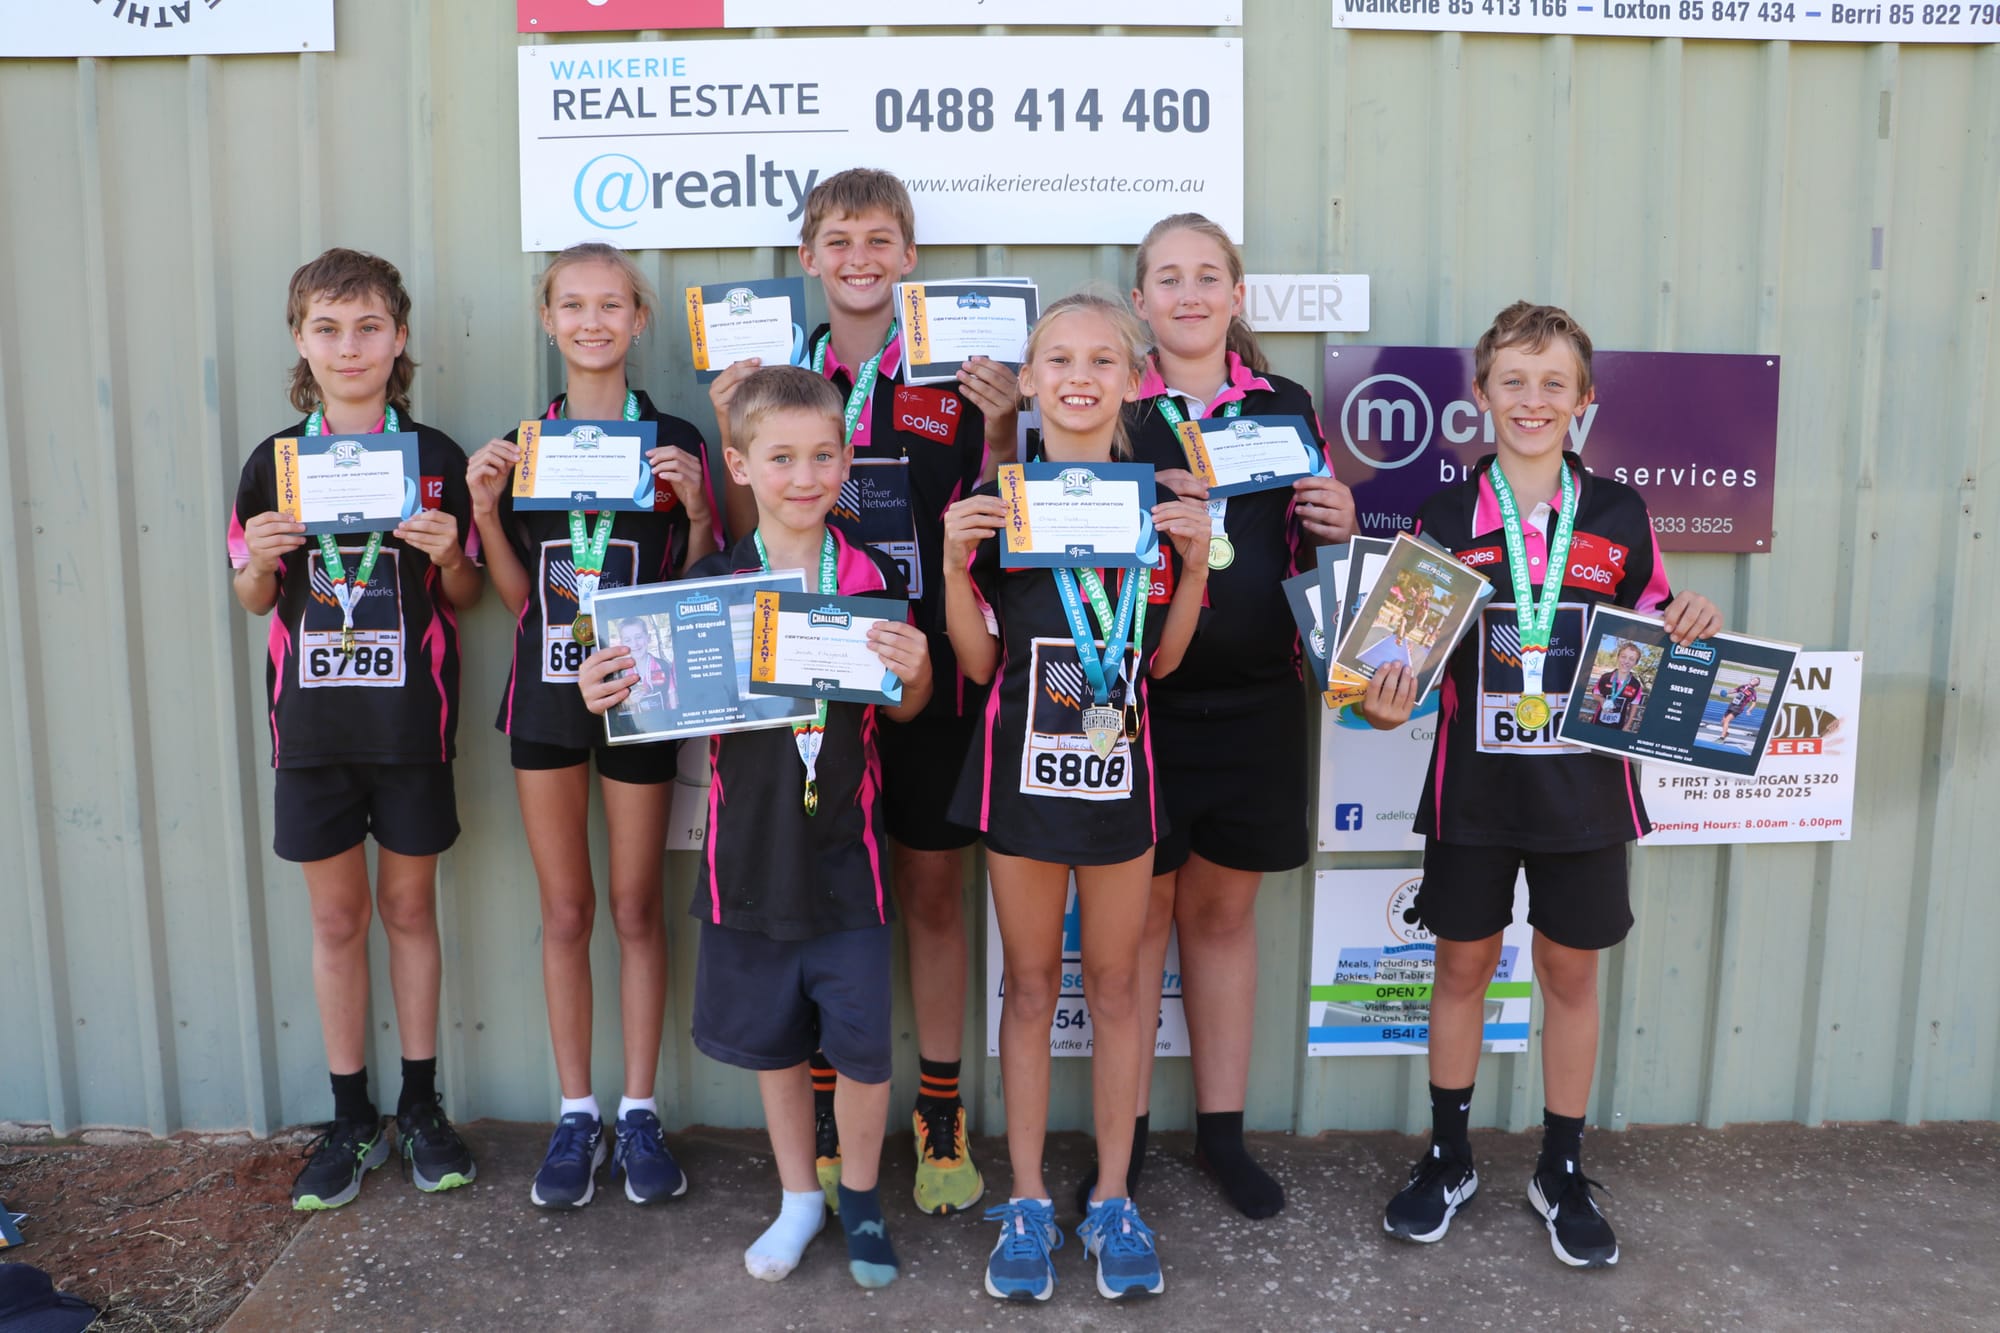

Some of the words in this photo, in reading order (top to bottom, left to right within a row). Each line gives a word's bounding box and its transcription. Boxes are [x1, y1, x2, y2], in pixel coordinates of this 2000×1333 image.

[1448, 0, 1473, 15] 85
[1482, 0, 1520, 16] 413
[1530, 0, 1567, 17] 166
[1604, 0, 1670, 20] Loxton
[1679, 1, 1702, 21] 85
[1711, 1, 1750, 22] 847
[1757, 2, 1796, 23] 434
[1832, 4, 1881, 24] Berri
[1889, 4, 1914, 25] 85
[1922, 4, 1961, 25] 822
[550, 57, 687, 80] WAIKERIE
[553, 86, 657, 121] REAL
[670, 82, 820, 118] ESTATE
[875, 87, 994, 133] 0488
[1014, 88, 1103, 132] 414
[1122, 88, 1210, 133] 460
[940, 397, 958, 415] 12
[902, 414, 949, 437] coles
[282, 444, 294, 505] PARTICIPANT
[861, 478, 875, 488] SA
[1066, 473, 1089, 487] SIC
[1614, 463, 1758, 488] services
[427, 481, 443, 498] 12
[862, 489, 891, 499] Power
[862, 498, 908, 509] Networks
[1008, 470, 1022, 533] PARTICIPANT
[1361, 512, 1413, 530] White
[1506, 515, 1519, 532] SA
[1691, 517, 1733, 533] 3525
[571, 519, 586, 554] Little
[1553, 536, 1568, 553] SA
[1460, 550, 1495, 567] coles
[1511, 534, 1529, 592] Athletics
[1608, 546, 1623, 567] 12
[1546, 554, 1564, 590] State
[1571, 563, 1613, 585] coles
[680, 601, 718, 616] CHALLENGE
[1519, 593, 1533, 630] Little
[1537, 592, 1556, 631] Event
[811, 615, 848, 626] CHALLENGE
[1072, 608, 1087, 637] STATE
[762, 598, 771, 663] PARTICIPANT
[310, 646, 394, 677] 6788
[1674, 645, 1713, 661] CHALLENGE
[1667, 662, 1688, 672] Noah
[1035, 752, 1125, 788] 6808
[1658, 777, 1666, 788] 5
[1672, 776, 1708, 787] FIRST
[1804, 773, 1839, 785] 5320
[1684, 789, 1707, 800] PH:
[1713, 789, 1730, 799] 08
[1736, 788, 1771, 799] 8540
[1776, 787, 1812, 798] 2025
[1649, 821, 1699, 832] Opening
[1703, 820, 1741, 830] Hours:
[1745, 819, 1788, 829] 8.00am
[1799, 817, 1842, 829] 6.00pm
[1392, 893, 1407, 916] THE
[1338, 959, 1371, 969] Meals,
[1335, 972, 1372, 982] Pokies,
[1374, 972, 1397, 981] Pool
[1376, 987, 1414, 998] OPEN
[1418, 986, 1427, 998] 7
[1364, 1003, 1401, 1012] Visitors
[1373, 1015, 1401, 1023] Crush
[1382, 1028, 1415, 1039] 8541
